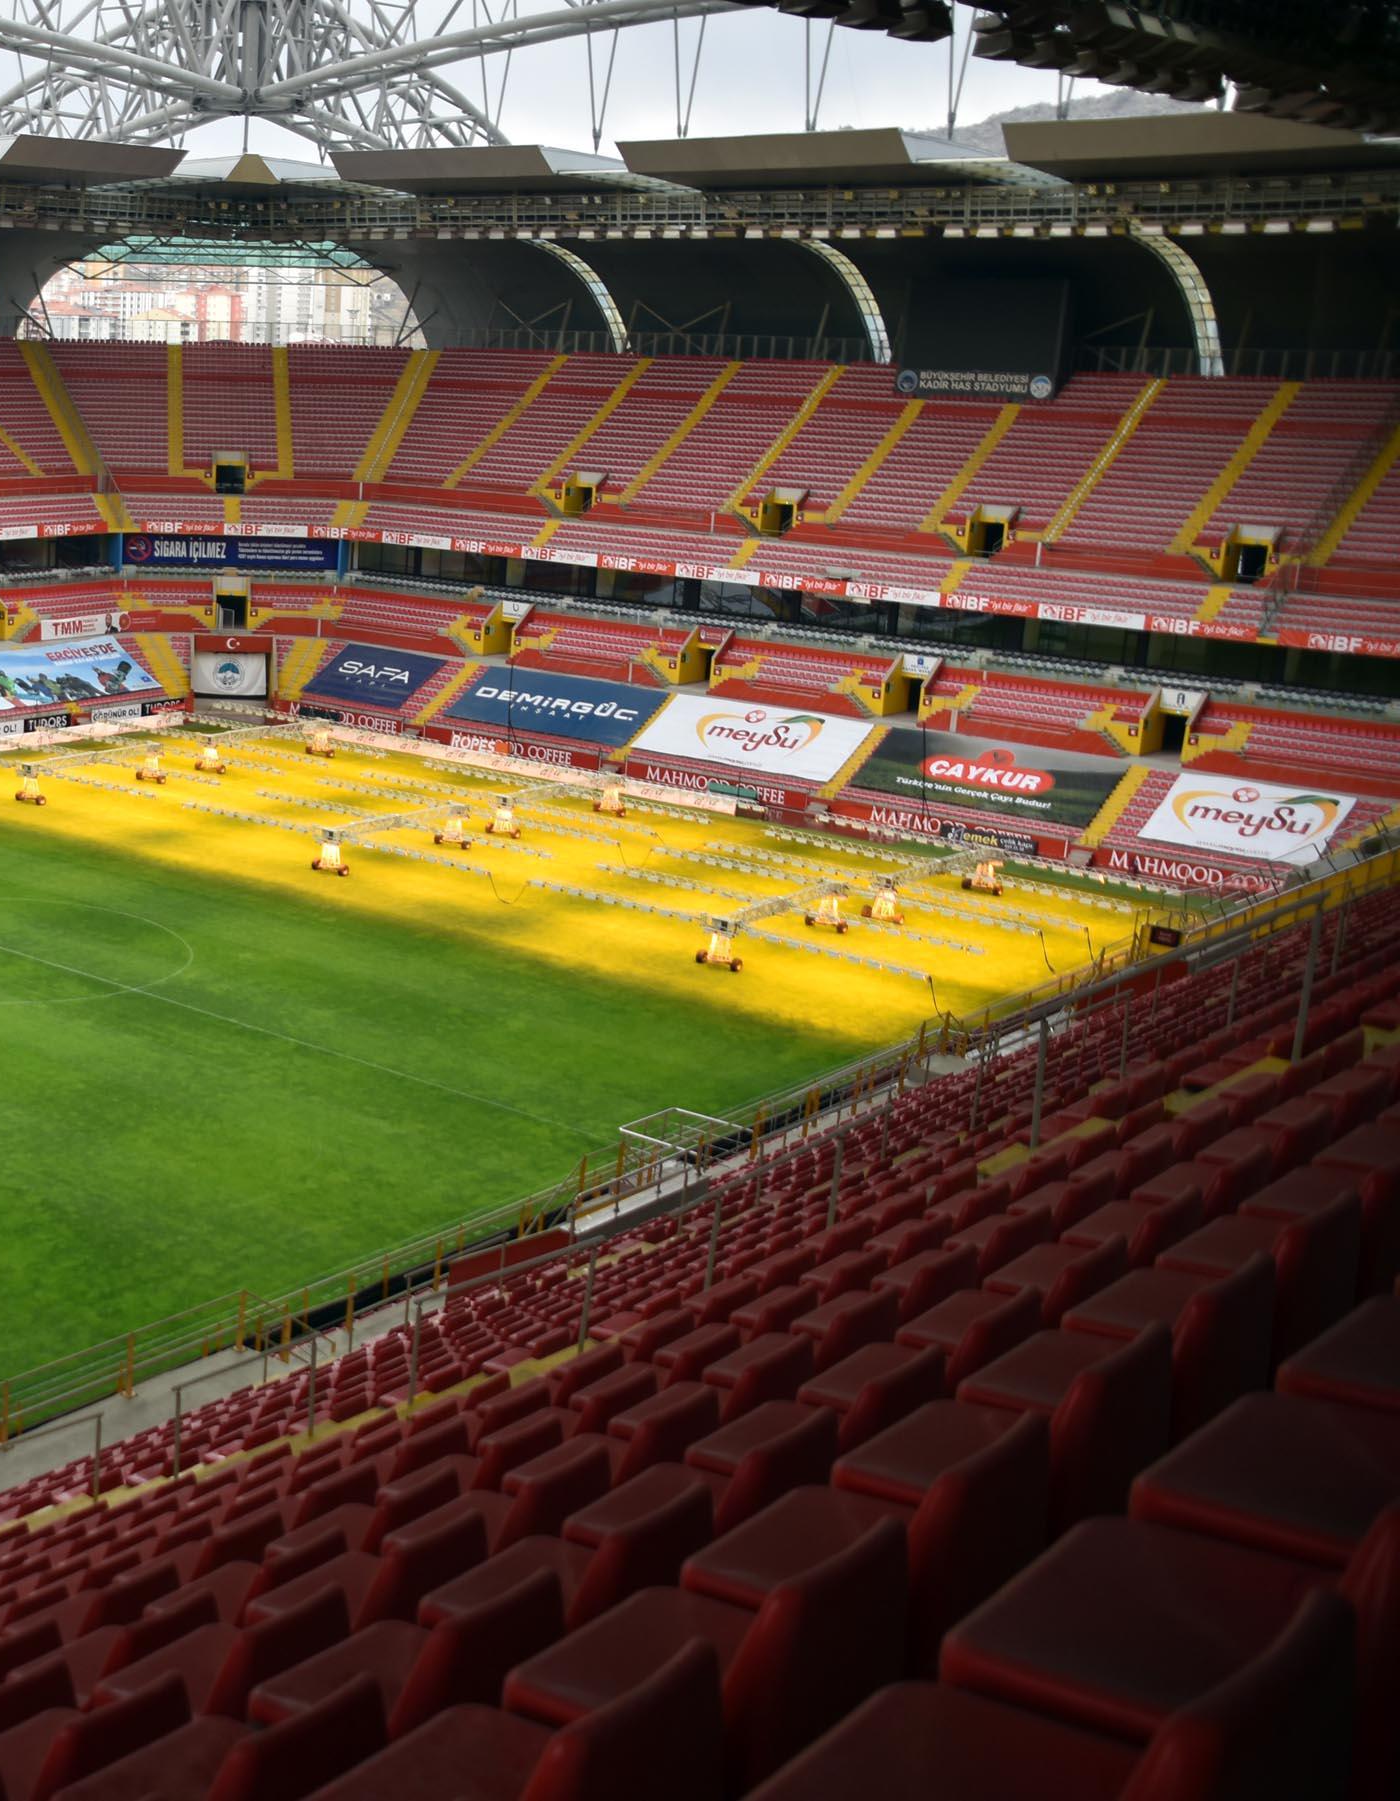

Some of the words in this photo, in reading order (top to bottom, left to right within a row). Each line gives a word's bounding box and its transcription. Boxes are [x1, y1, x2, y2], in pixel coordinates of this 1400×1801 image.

[951, 381, 974, 390] HAS
[974, 381, 1028, 393] STADYUMU
[154, 536, 187, 559] SİGARA
[188, 536, 227, 562] İÇİLMEZ
[52, 620, 83, 636] TMM
[45, 642, 118, 662] ERCİYES'DE
[338, 660, 410, 684] SAFA
[128, 707, 140, 718] OL!
[3, 723, 17, 735] OL!
[28, 714, 68, 731] TUDORS
[357, 715, 397, 734] COFFEE
[528, 745, 572, 765] COFFEE
[929, 759, 1042, 791] ÇAYKUR
[1015, 796, 1052, 809] Budur!
[963, 832, 998, 847] emek
[1108, 849, 1223, 887] MAHMOOD
